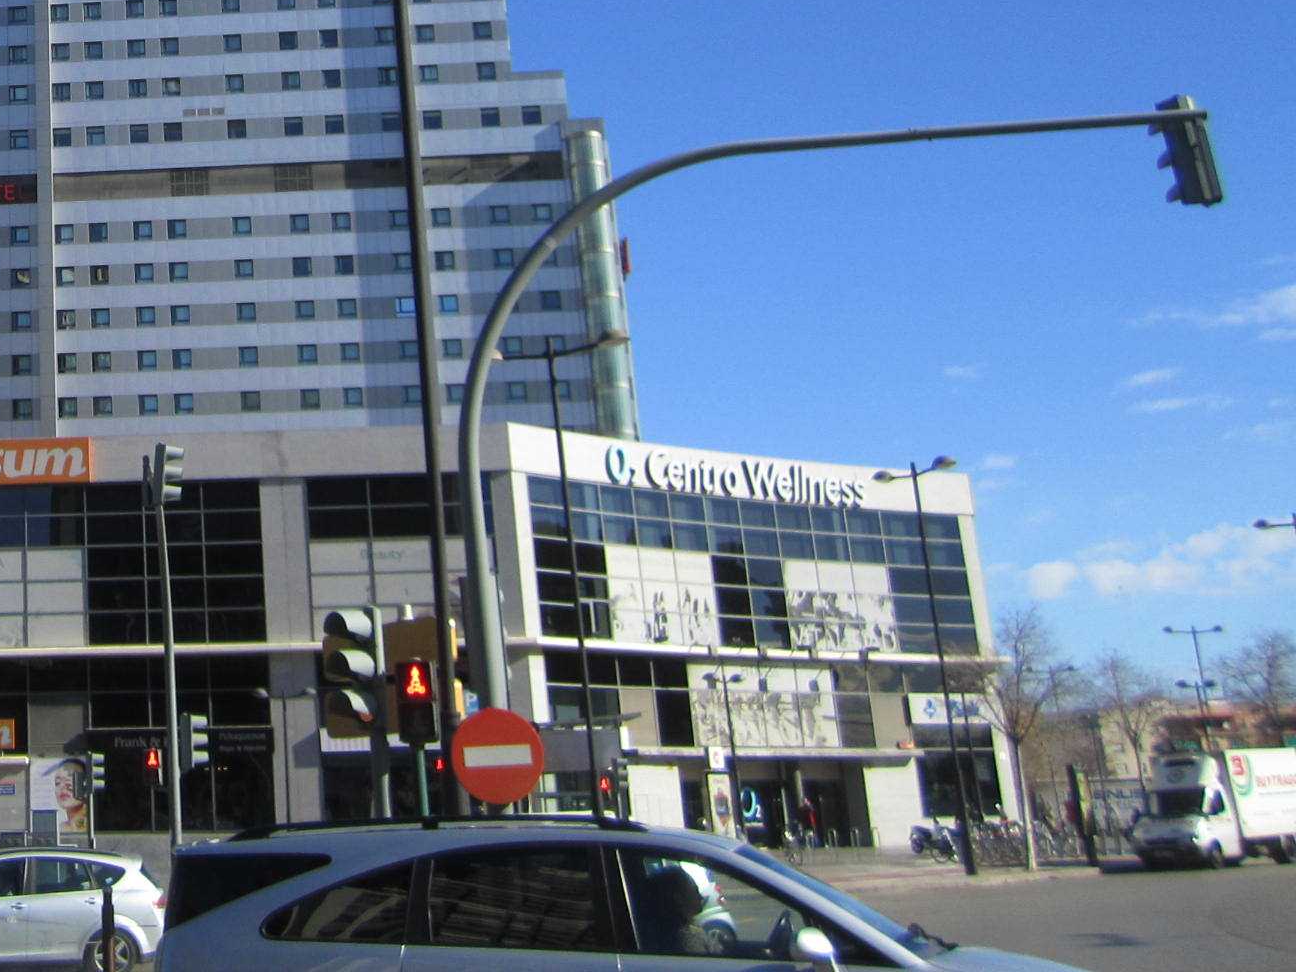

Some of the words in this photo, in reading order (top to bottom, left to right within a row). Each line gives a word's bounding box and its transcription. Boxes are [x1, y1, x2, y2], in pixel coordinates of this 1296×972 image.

[645, 449, 745, 497] Centro
[741, 459, 865, 509] Wellness
[113, 736, 148, 748] Frank
